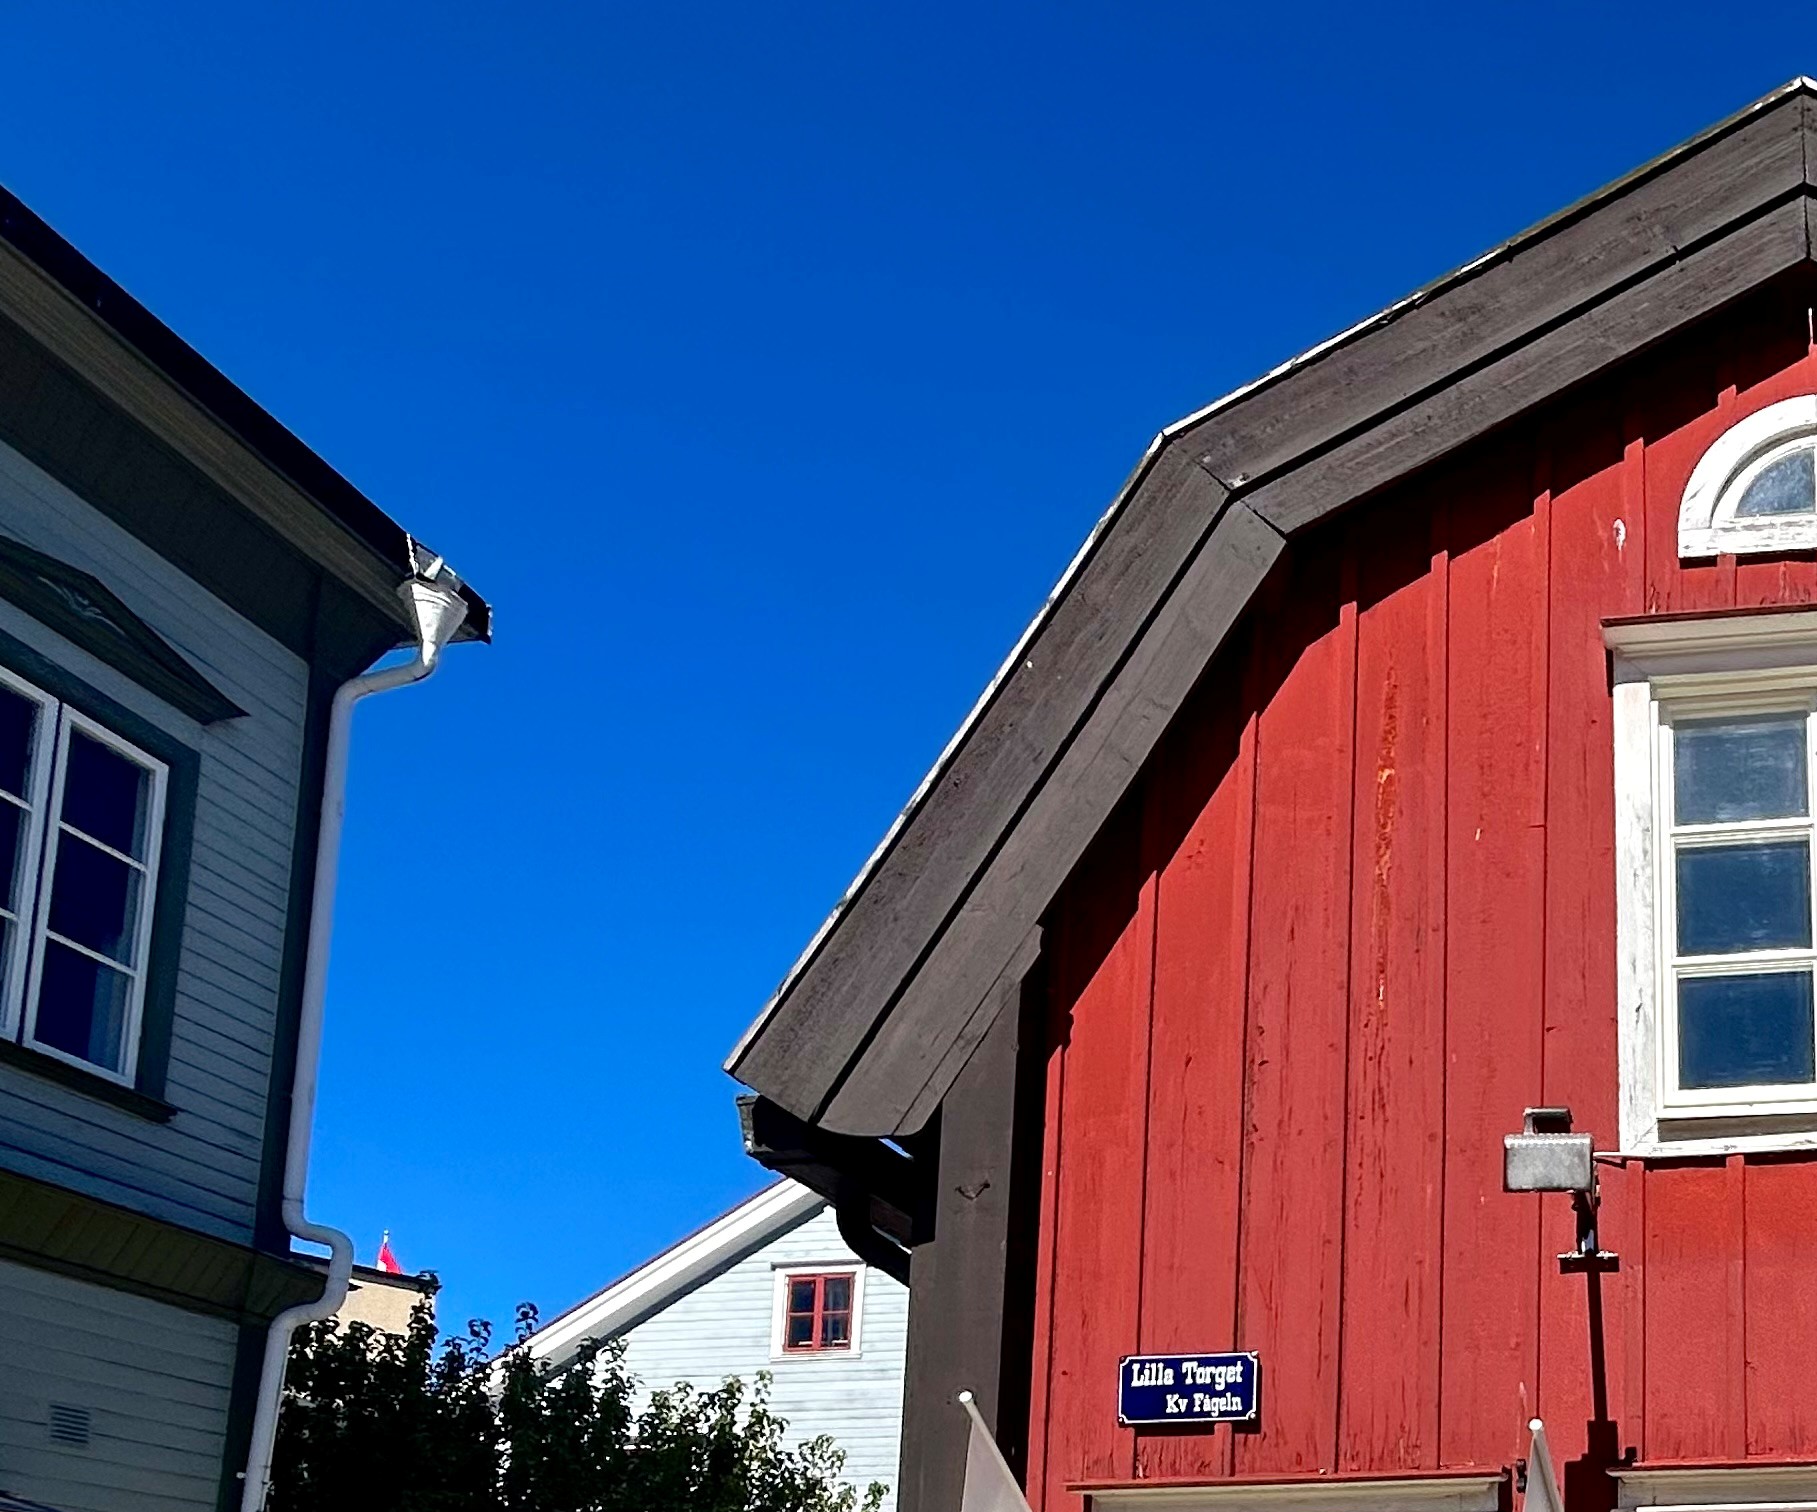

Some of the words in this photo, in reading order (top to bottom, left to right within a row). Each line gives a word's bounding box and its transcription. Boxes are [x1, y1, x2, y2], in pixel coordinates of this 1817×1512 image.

[1131, 1362, 1174, 1387] Lilla
[1182, 1361, 1243, 1391] Torget
[1166, 1393, 1188, 1413] Kv
[1193, 1392, 1243, 1417] Fågeln
